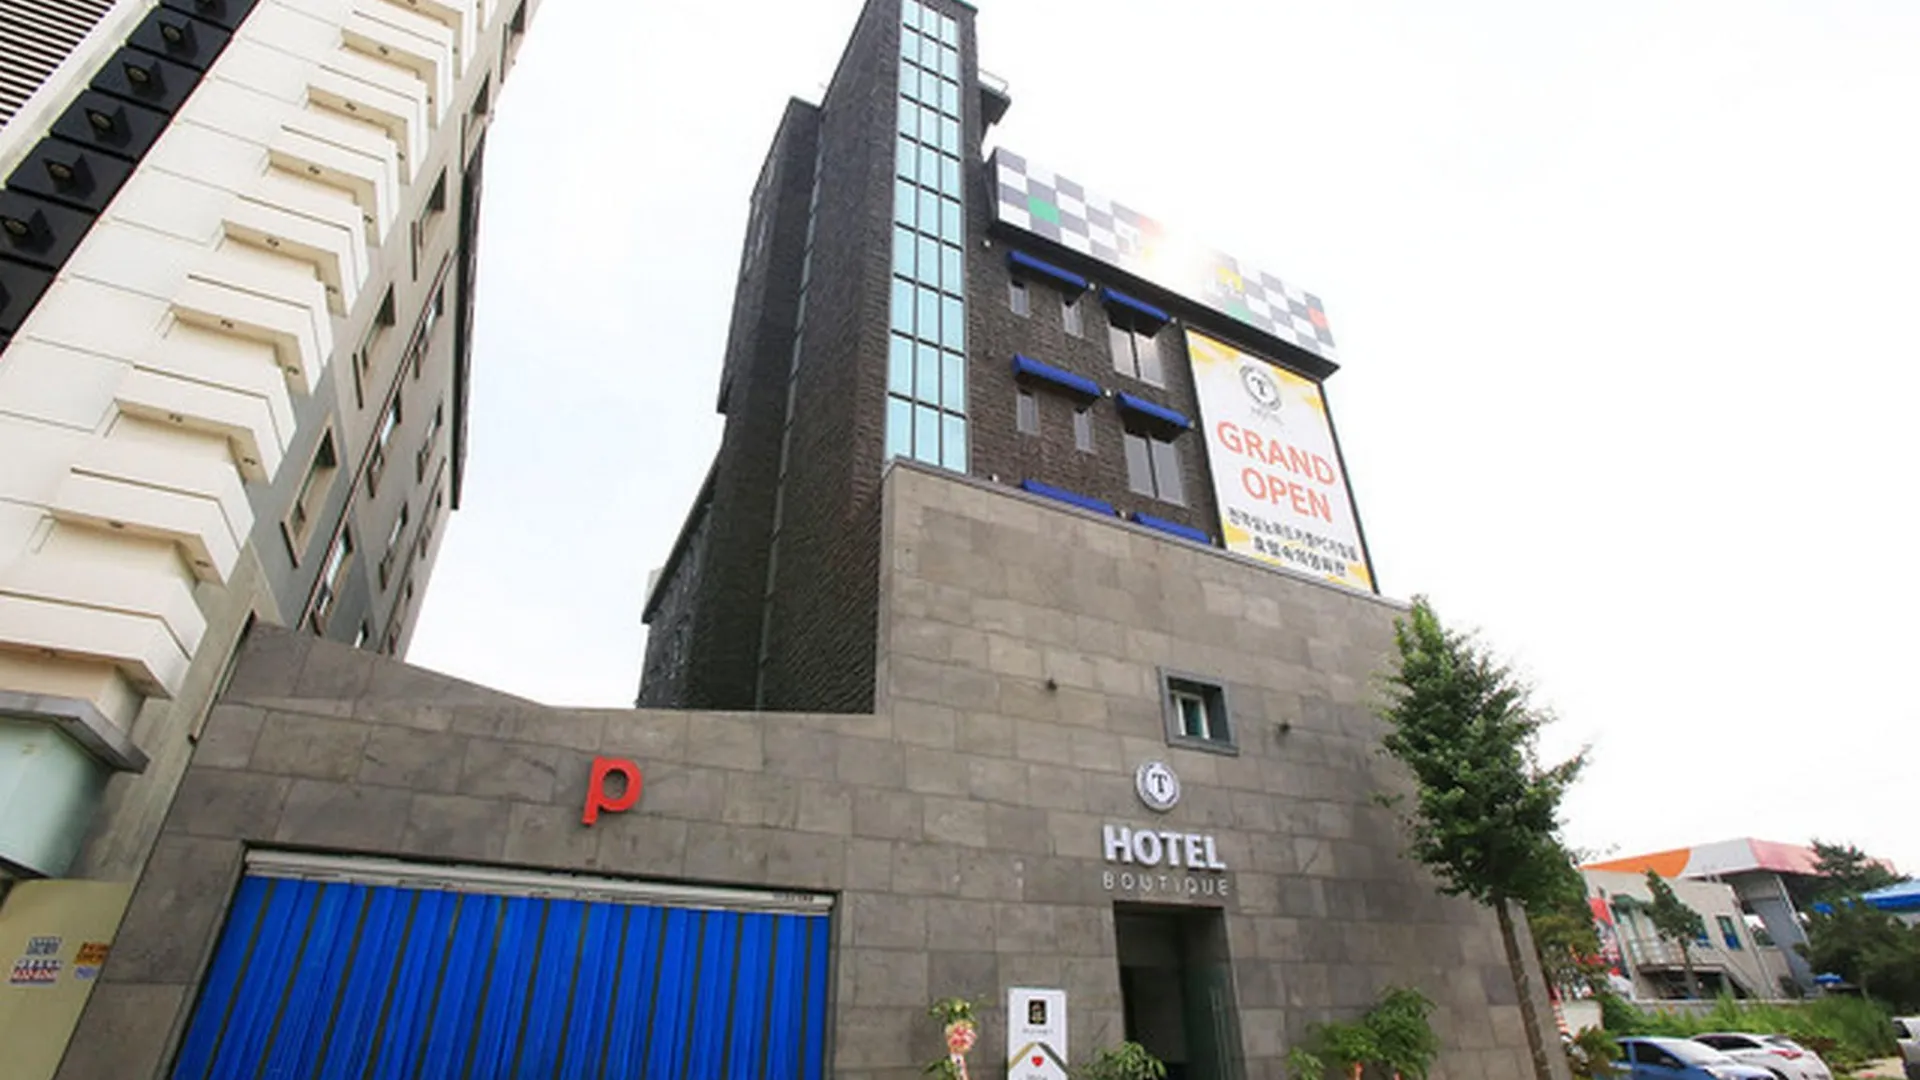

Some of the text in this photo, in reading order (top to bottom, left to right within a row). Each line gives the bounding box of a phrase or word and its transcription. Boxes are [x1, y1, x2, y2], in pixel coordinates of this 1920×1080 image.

[1216, 421, 1336, 486] GRAND
[1240, 466, 1333, 523] OPEN
[1103, 824, 1227, 870] HOTEL
[1102, 870, 1230, 896] BOUTIQUE
